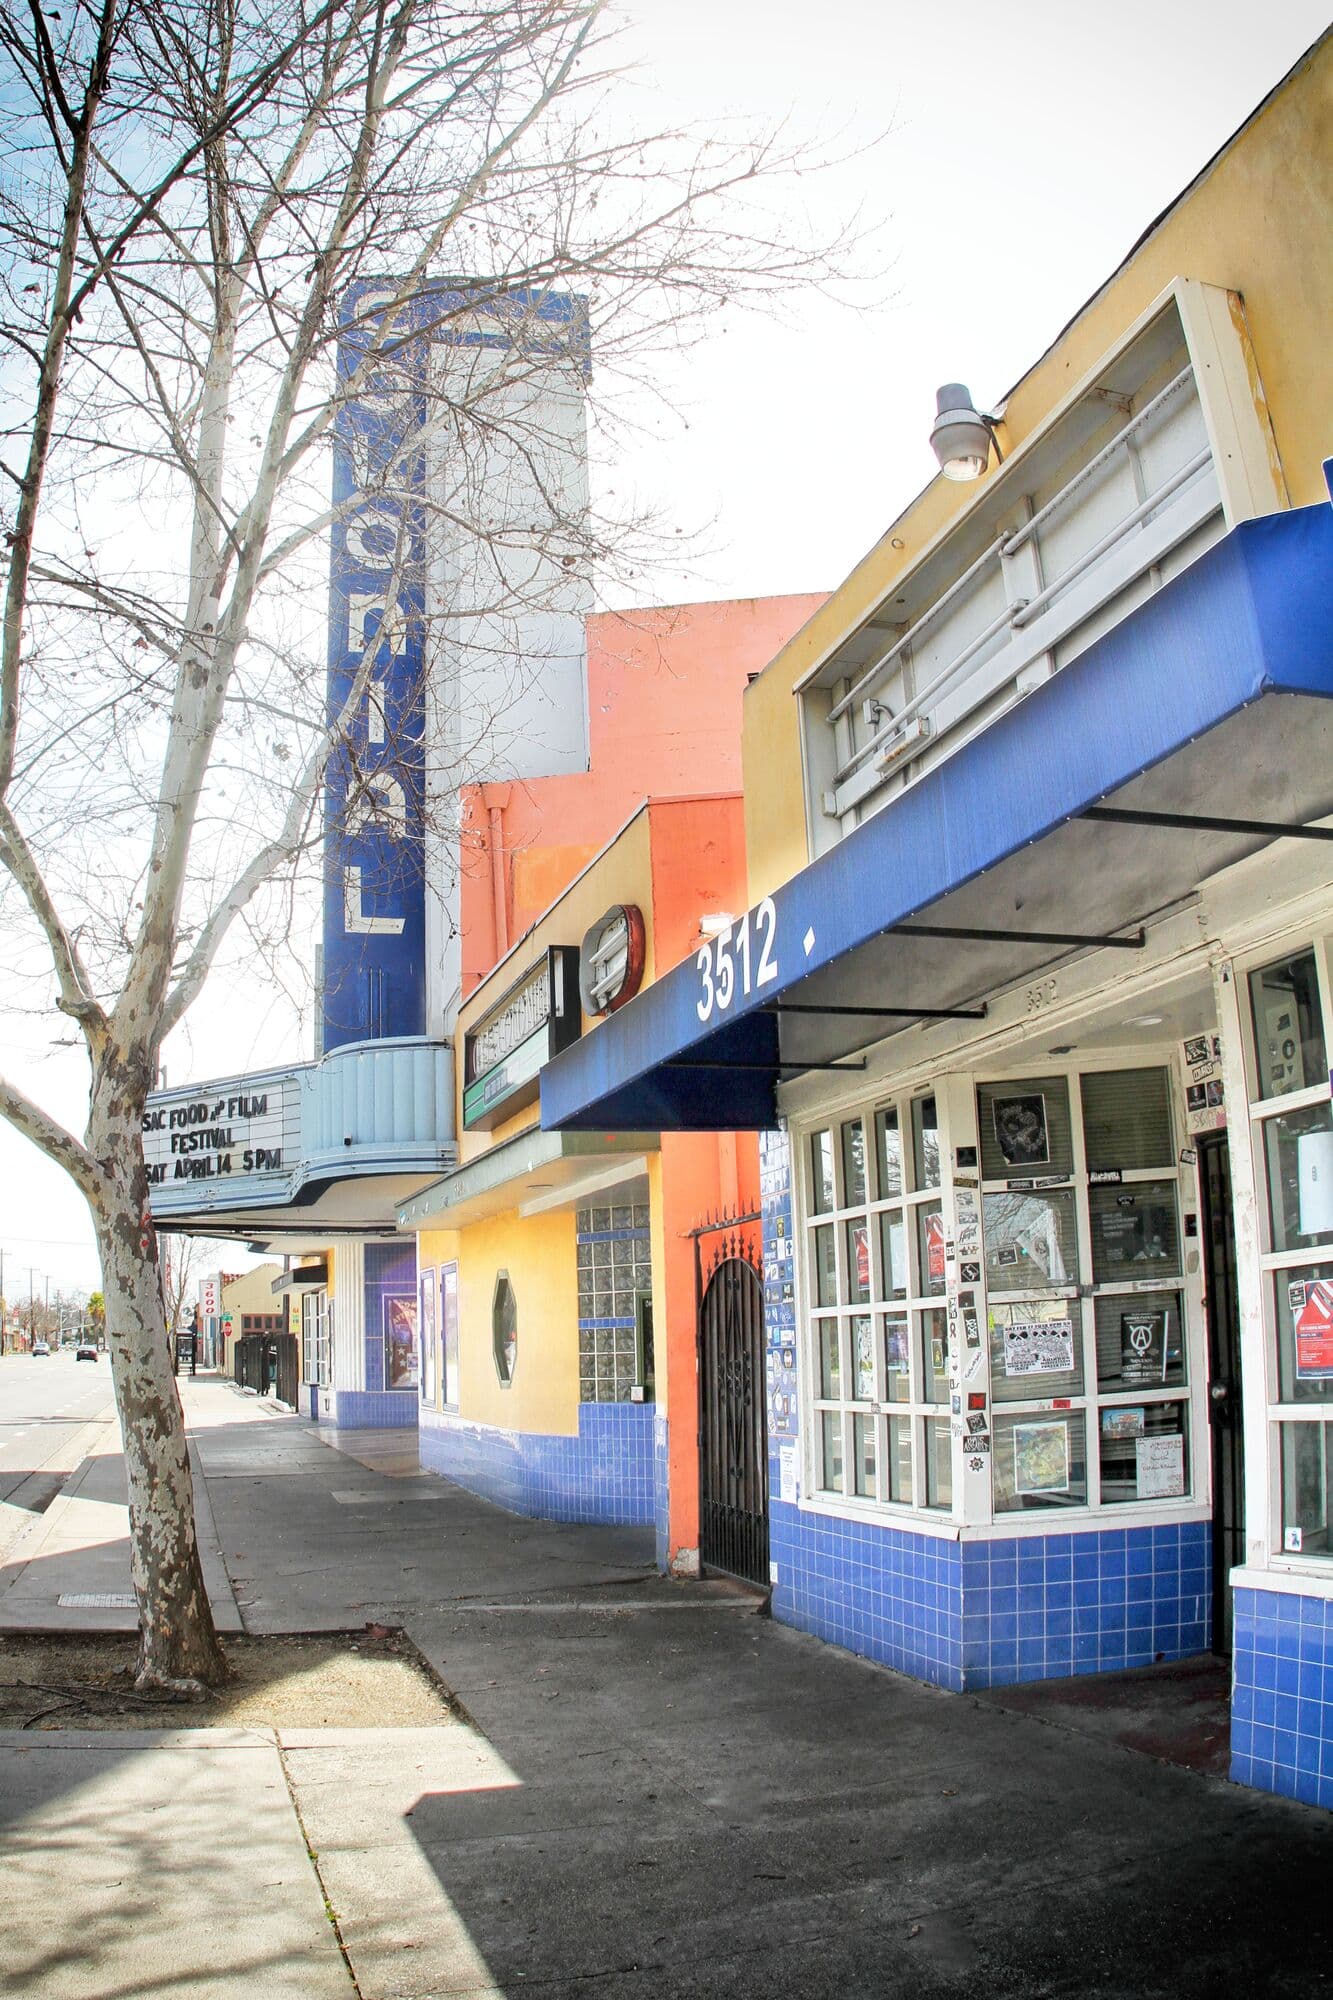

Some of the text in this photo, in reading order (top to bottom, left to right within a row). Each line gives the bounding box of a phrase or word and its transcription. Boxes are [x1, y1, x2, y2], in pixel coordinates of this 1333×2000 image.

[695, 895, 778, 1022] 3512
[142, 1109, 166, 1132] SAC
[169, 1103, 208, 1129] FOOD
[228, 1094, 268, 1119] FILM
[170, 1127, 236, 1154] FESTIVAL
[144, 1163, 168, 1184] SAT
[173, 1155, 215, 1179] APRIL
[217, 1153, 232, 1175] 14
[204, 1282, 215, 1314] 3600
